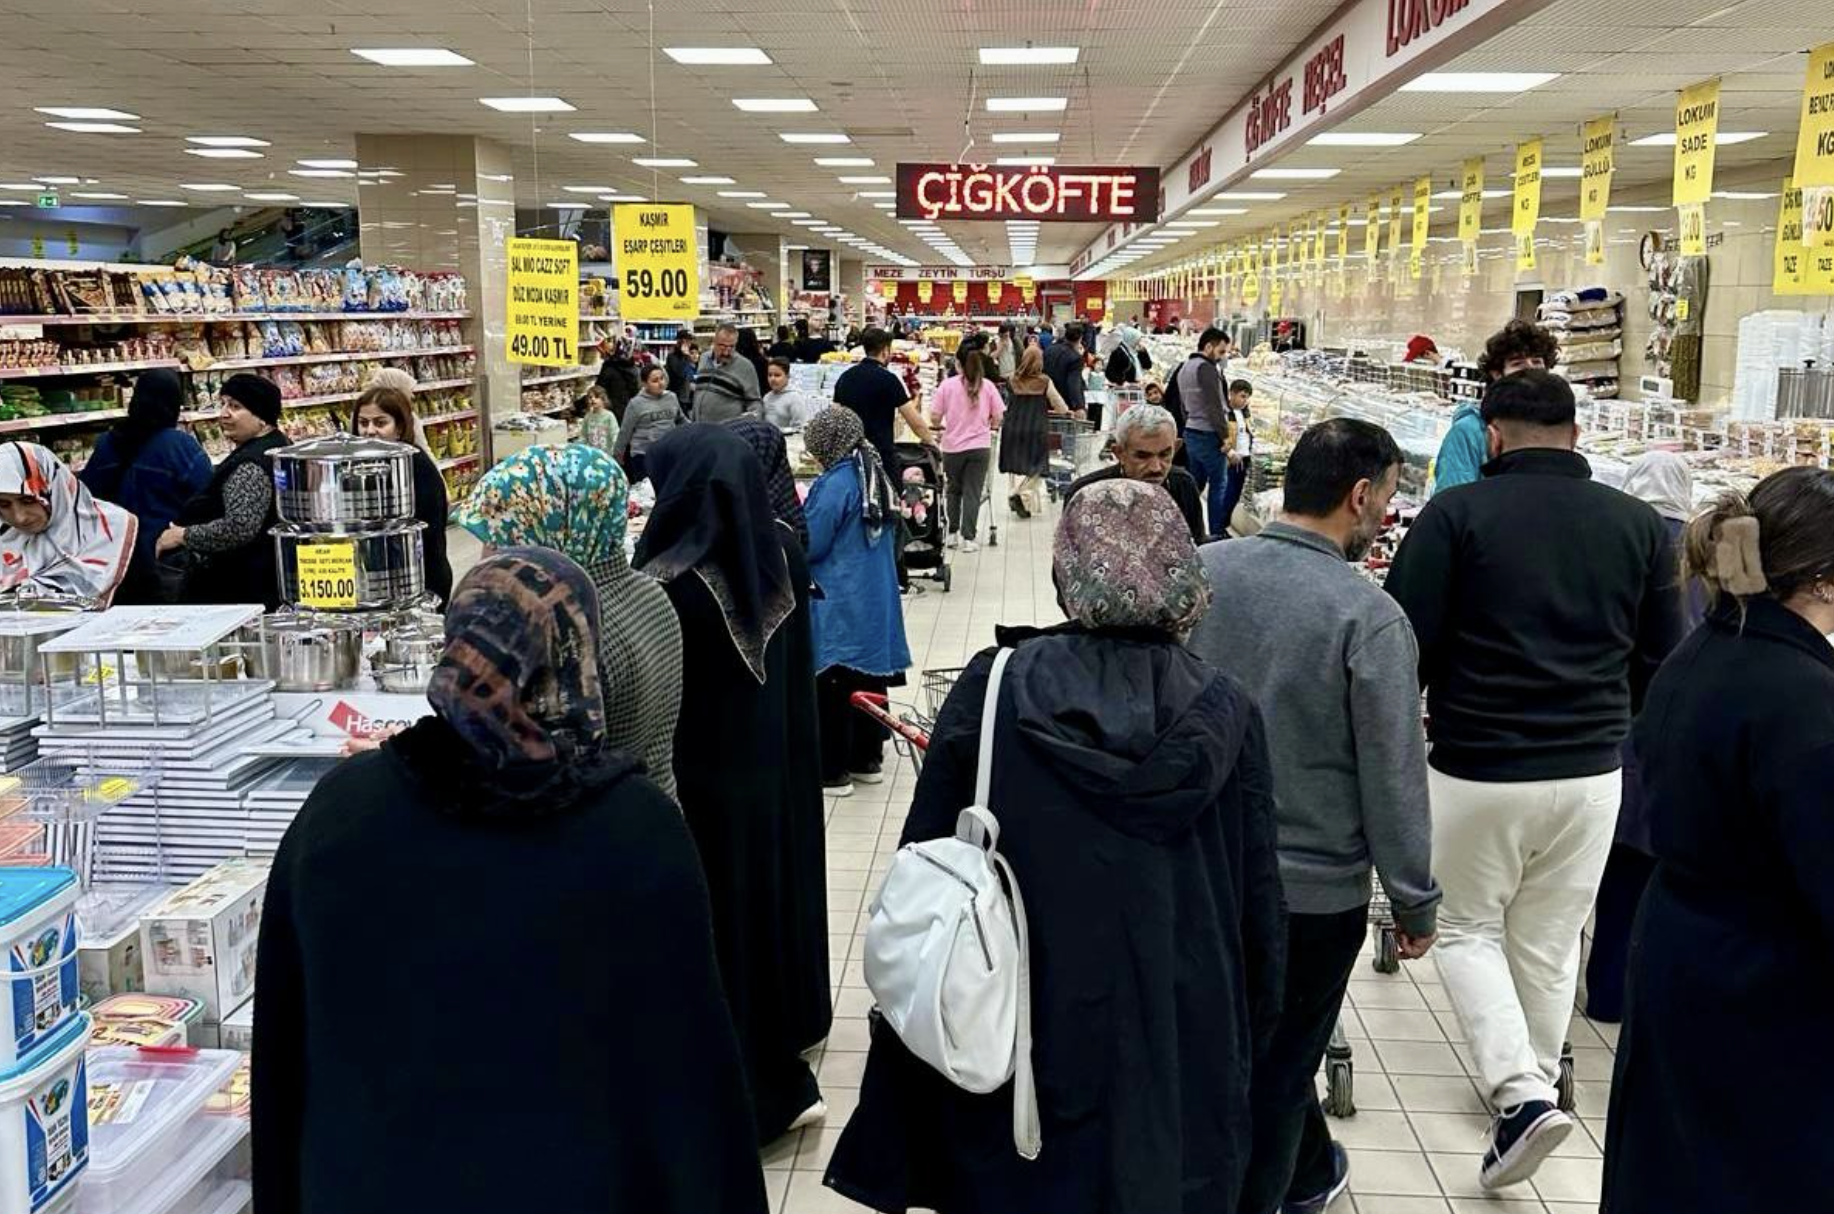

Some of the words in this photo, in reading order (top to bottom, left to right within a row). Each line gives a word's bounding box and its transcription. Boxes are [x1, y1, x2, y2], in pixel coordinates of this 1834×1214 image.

[1302, 33, 1347, 115] REÇEL
[1678, 101, 1715, 127] LOKUM
[1585, 132, 1611, 154] LOKUM
[1681, 133, 1707, 155] SADE
[1817, 131, 1834, 156] KG
[1584, 156, 1610, 179] GÜLLÜ
[1685, 164, 1697, 181] KG
[917, 164, 1136, 219] ÇİĞKÖFTE
[640, 210, 668, 231] KAŞMİR
[624, 239, 648, 257] EŞARP
[554, 258, 571, 275] SOFT
[874, 269, 904, 278] MEZE
[918, 267, 958, 278] ZEYTİN
[970, 269, 1006, 279] TURŞU
[626, 269, 687, 298] 59.00
[544, 286, 569, 308] KAŞMİR
[538, 315, 567, 328] YERİNE
[512, 334, 549, 358] 49.00
[553, 337, 572, 360] TL
[300, 579, 354, 598] 3.150.00
